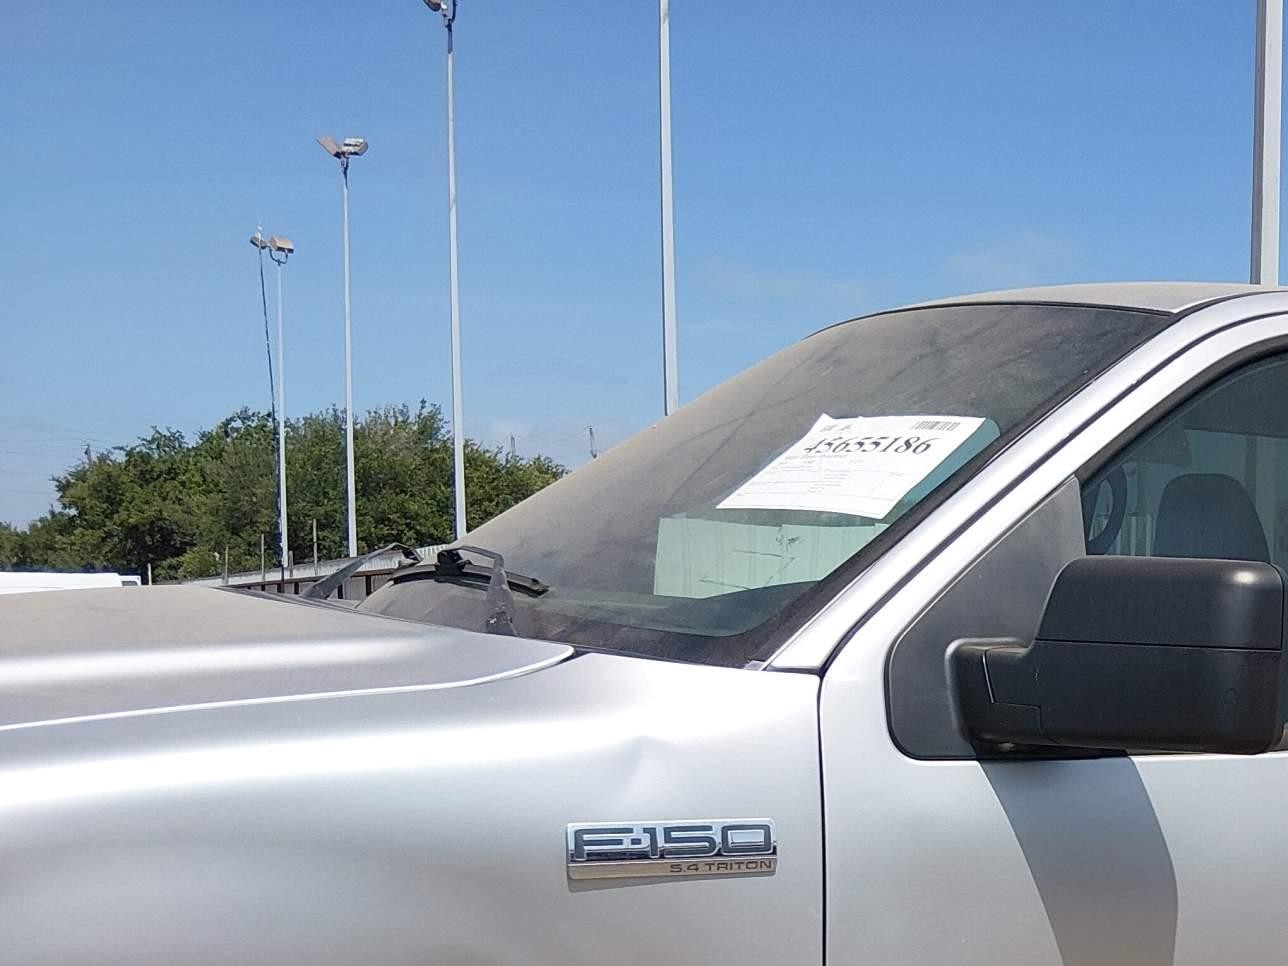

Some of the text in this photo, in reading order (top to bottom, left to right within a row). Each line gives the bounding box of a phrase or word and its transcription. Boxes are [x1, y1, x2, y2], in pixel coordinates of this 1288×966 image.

[803, 435, 940, 455] 45655186
[669, 860, 773, 873] 5.4 TRITON
